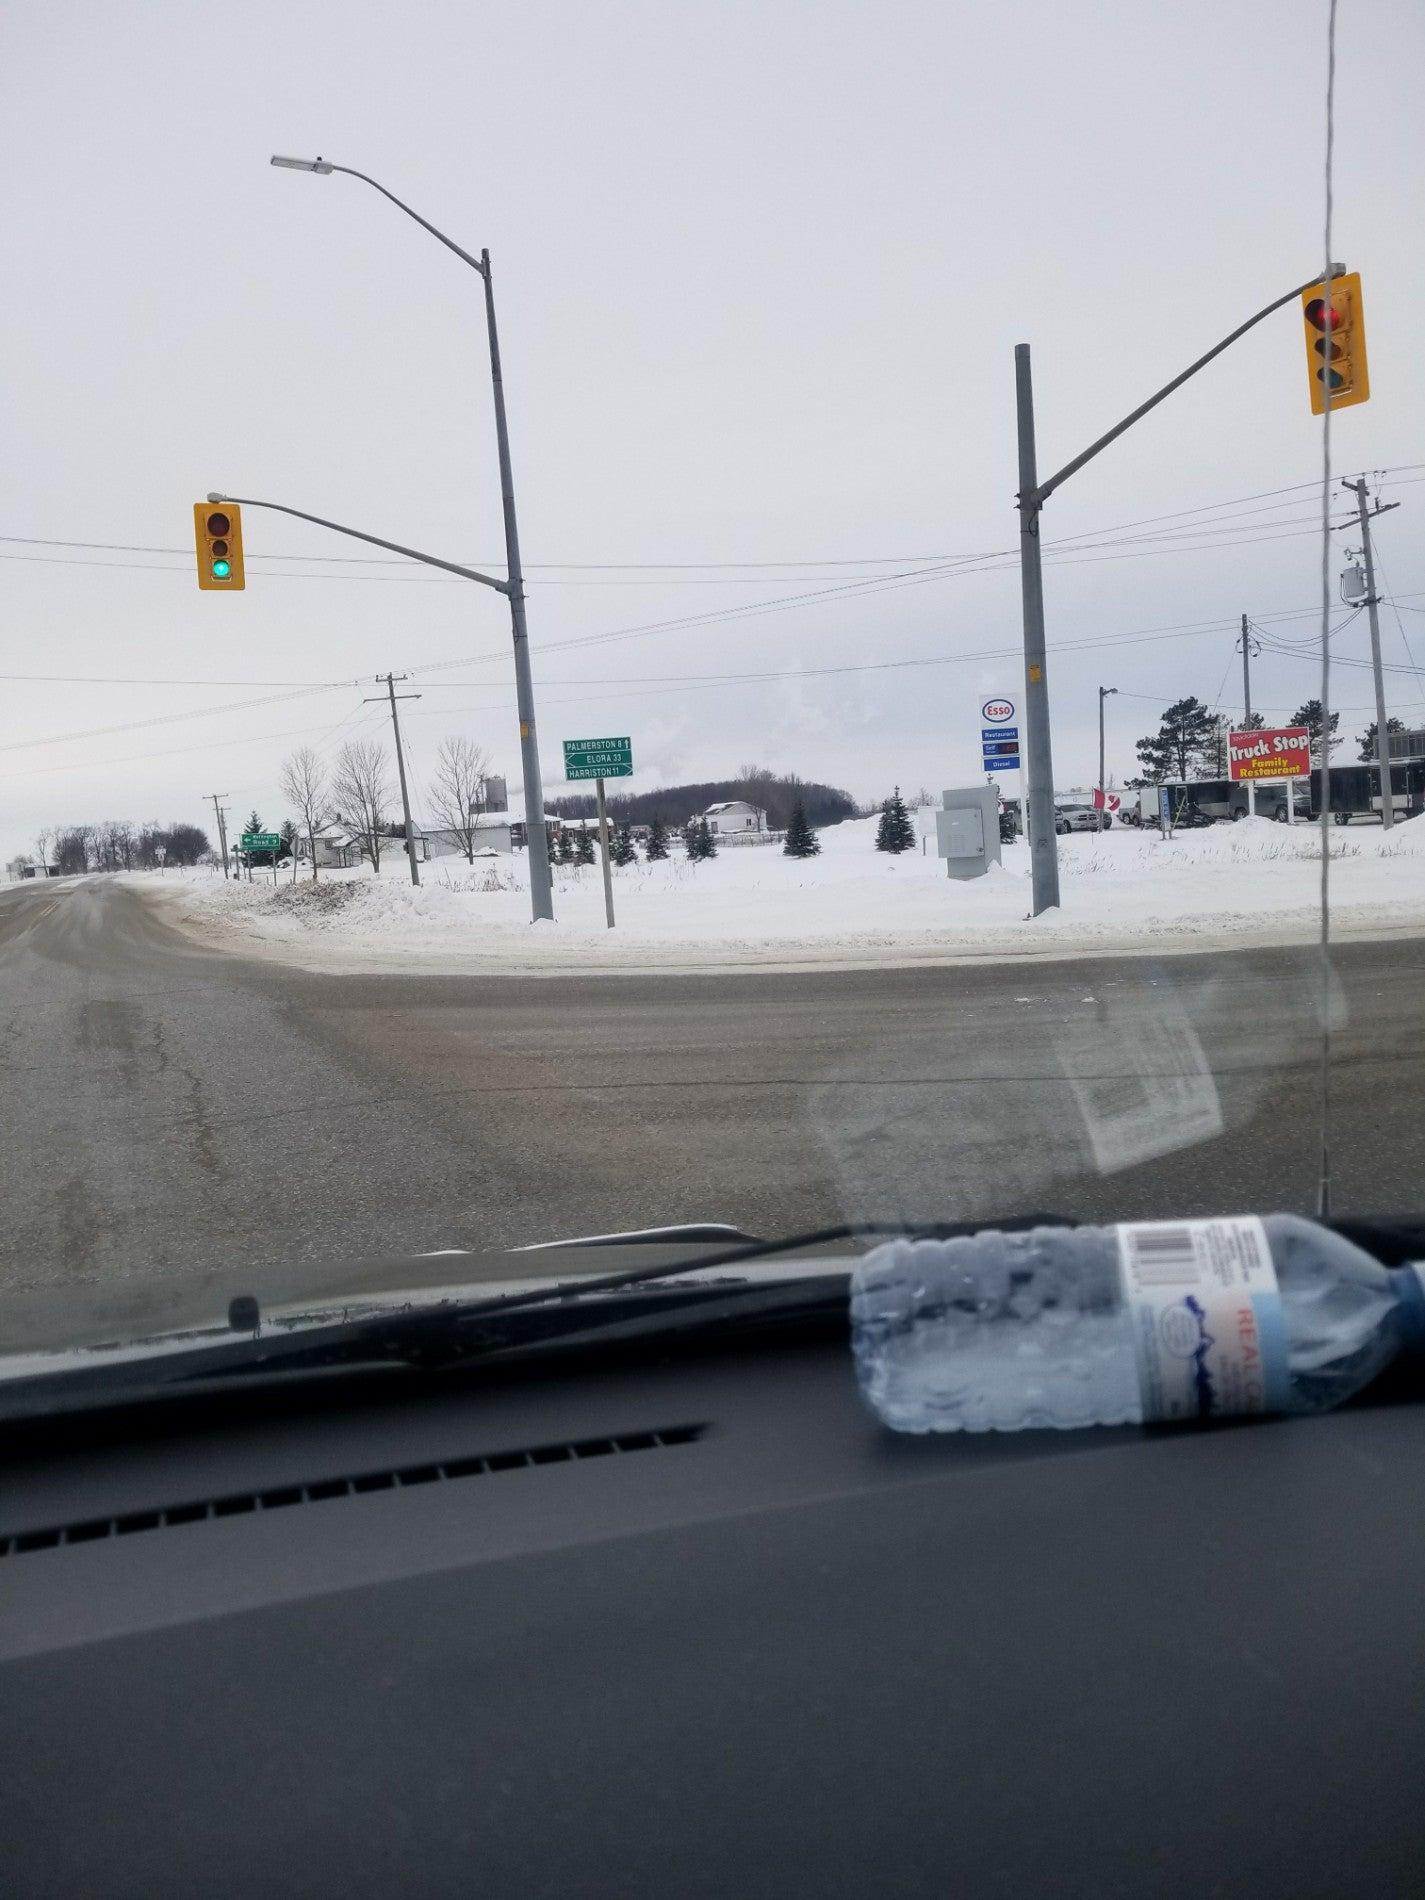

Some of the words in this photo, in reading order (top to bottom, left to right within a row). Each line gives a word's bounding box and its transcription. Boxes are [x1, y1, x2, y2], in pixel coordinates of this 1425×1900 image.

[566, 741, 616, 751] PALMERSTON
[1229, 739, 1271, 761] Truck
[1273, 735, 1309, 752] Stop
[586, 754, 612, 764] ELORA
[613, 753, 622, 762] 33
[1251, 757, 1289, 768] Family
[569, 767, 612, 778] HARRISTON
[612, 767, 619, 775] 11
[1239, 765, 1302, 777] Restaurant
